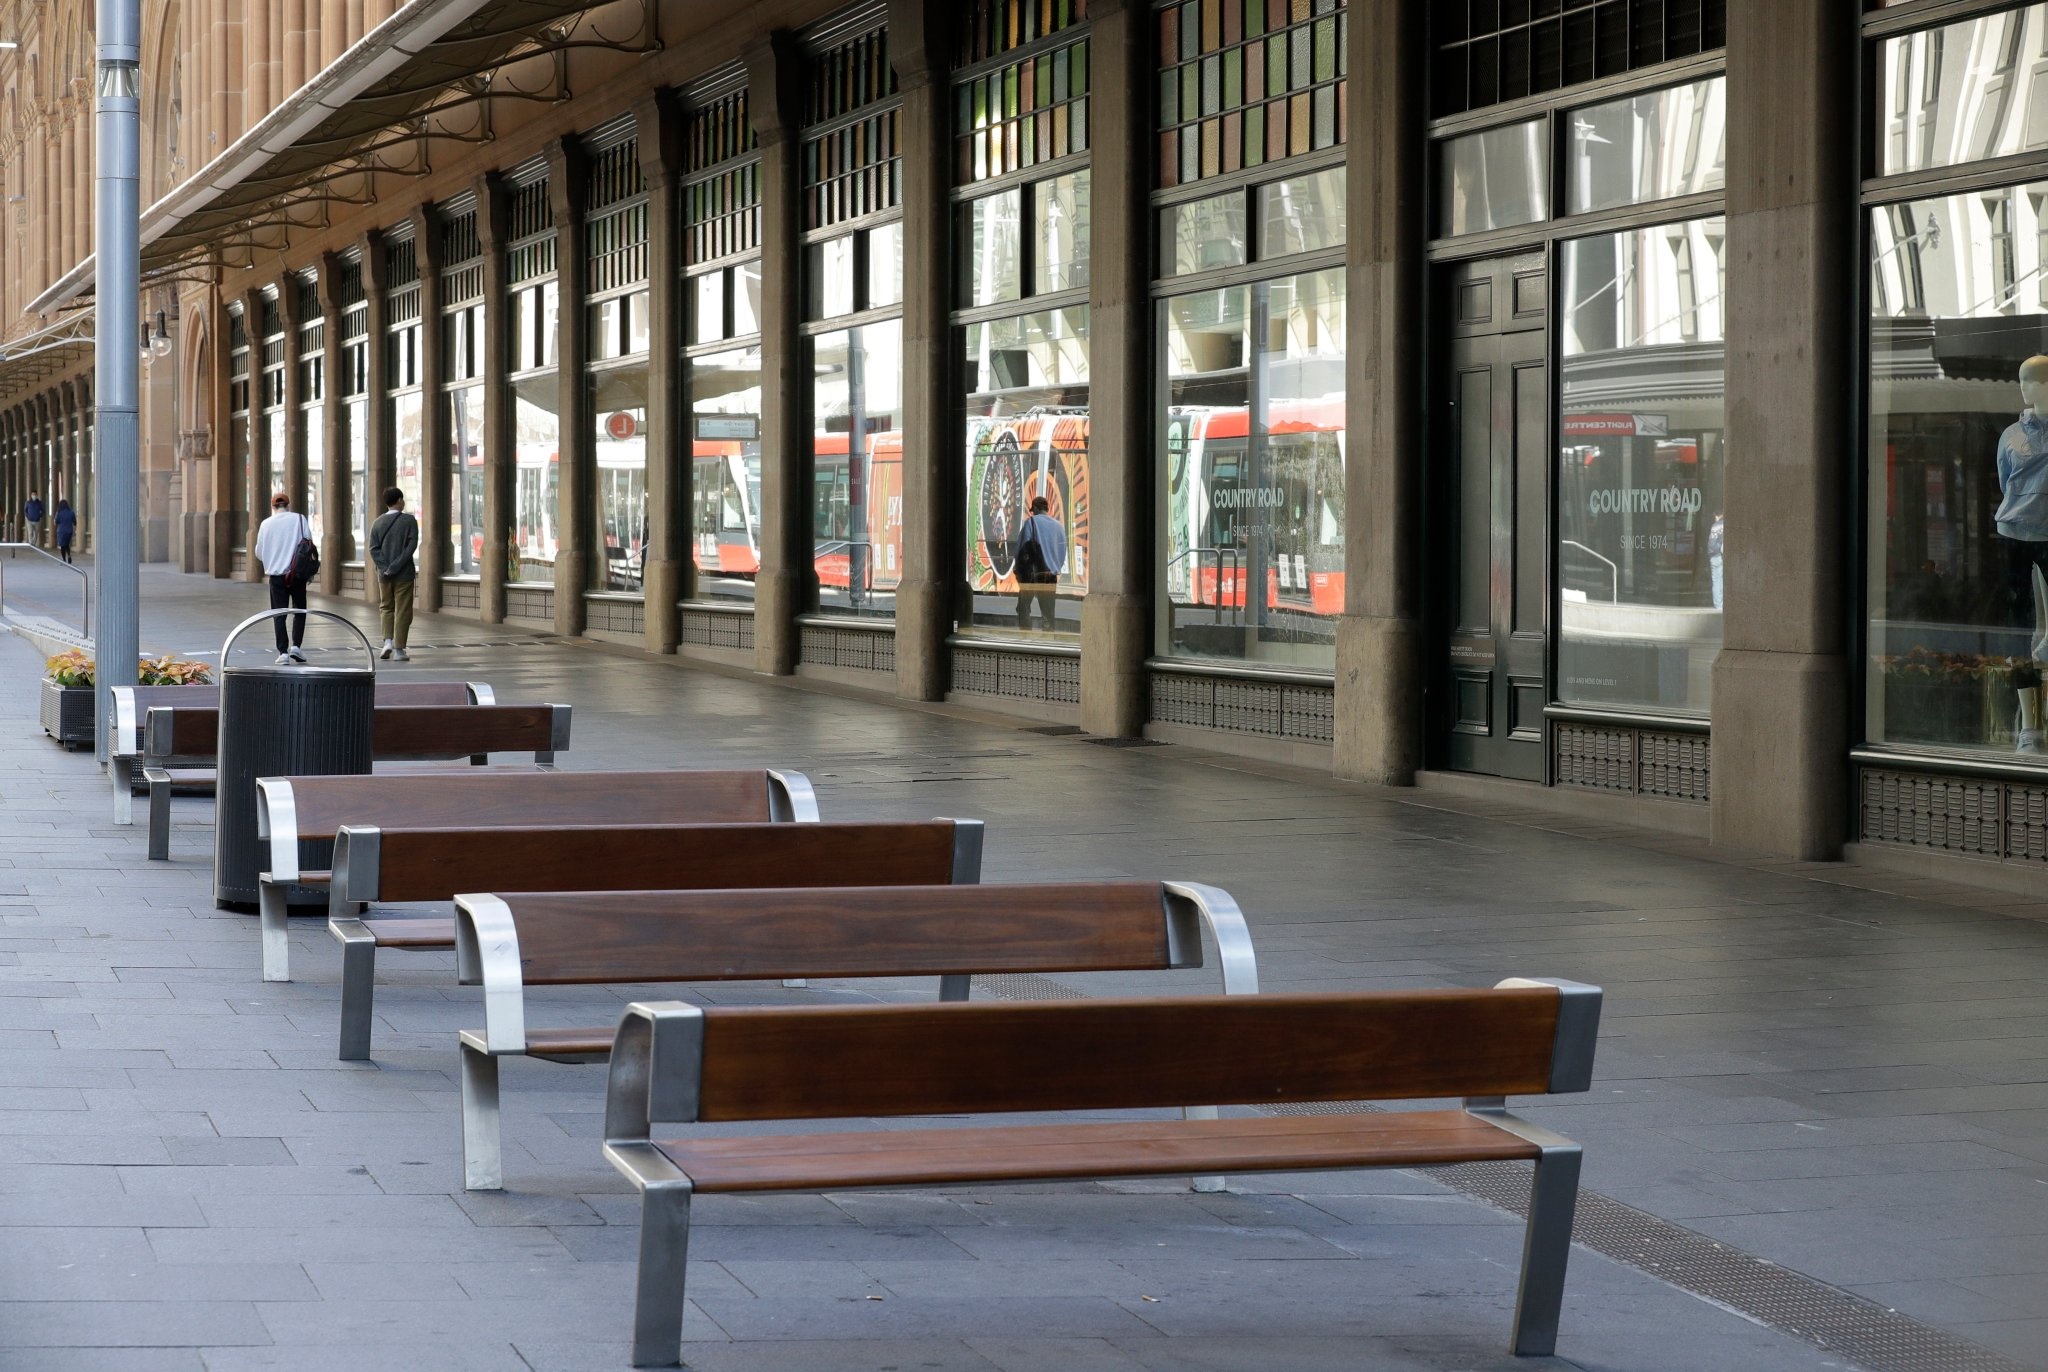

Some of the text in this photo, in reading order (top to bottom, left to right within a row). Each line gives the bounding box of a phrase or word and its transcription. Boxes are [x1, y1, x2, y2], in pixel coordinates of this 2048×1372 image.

[1214, 487, 1284, 509] COUNTRY ROAD
[1589, 487, 1702, 514] COUNTRY ROAD
[1232, 525, 1263, 537] SINCE 1974
[1620, 535, 1668, 549] SINCE 1974
